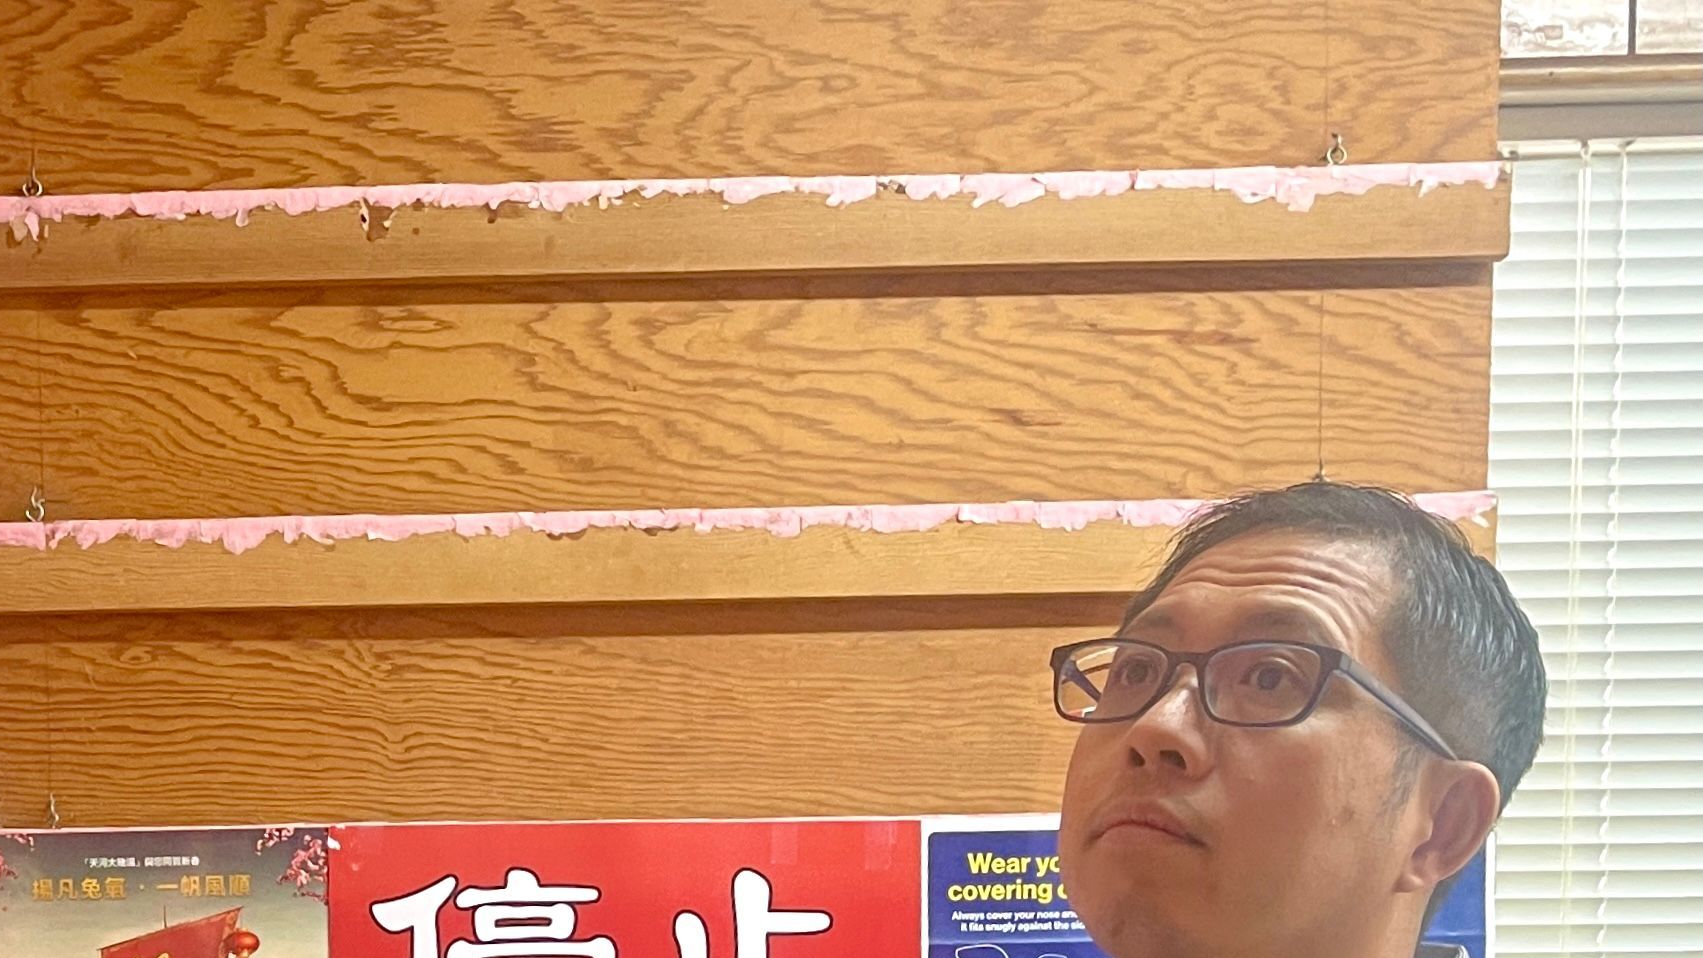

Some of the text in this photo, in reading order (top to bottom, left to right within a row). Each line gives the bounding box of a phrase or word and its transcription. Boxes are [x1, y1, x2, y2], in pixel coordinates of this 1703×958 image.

[967, 852, 1031, 874] Wear
[947, 878, 1053, 904] covering
[952, 911, 984, 922] Always
[986, 911, 1013, 920] cover
[1014, 911, 1035, 922] your
[1037, 911, 1060, 919] nose
[985, 922, 1016, 933] snugly
[1017, 921, 1052, 932] against
[1054, 921, 1069, 930] the
